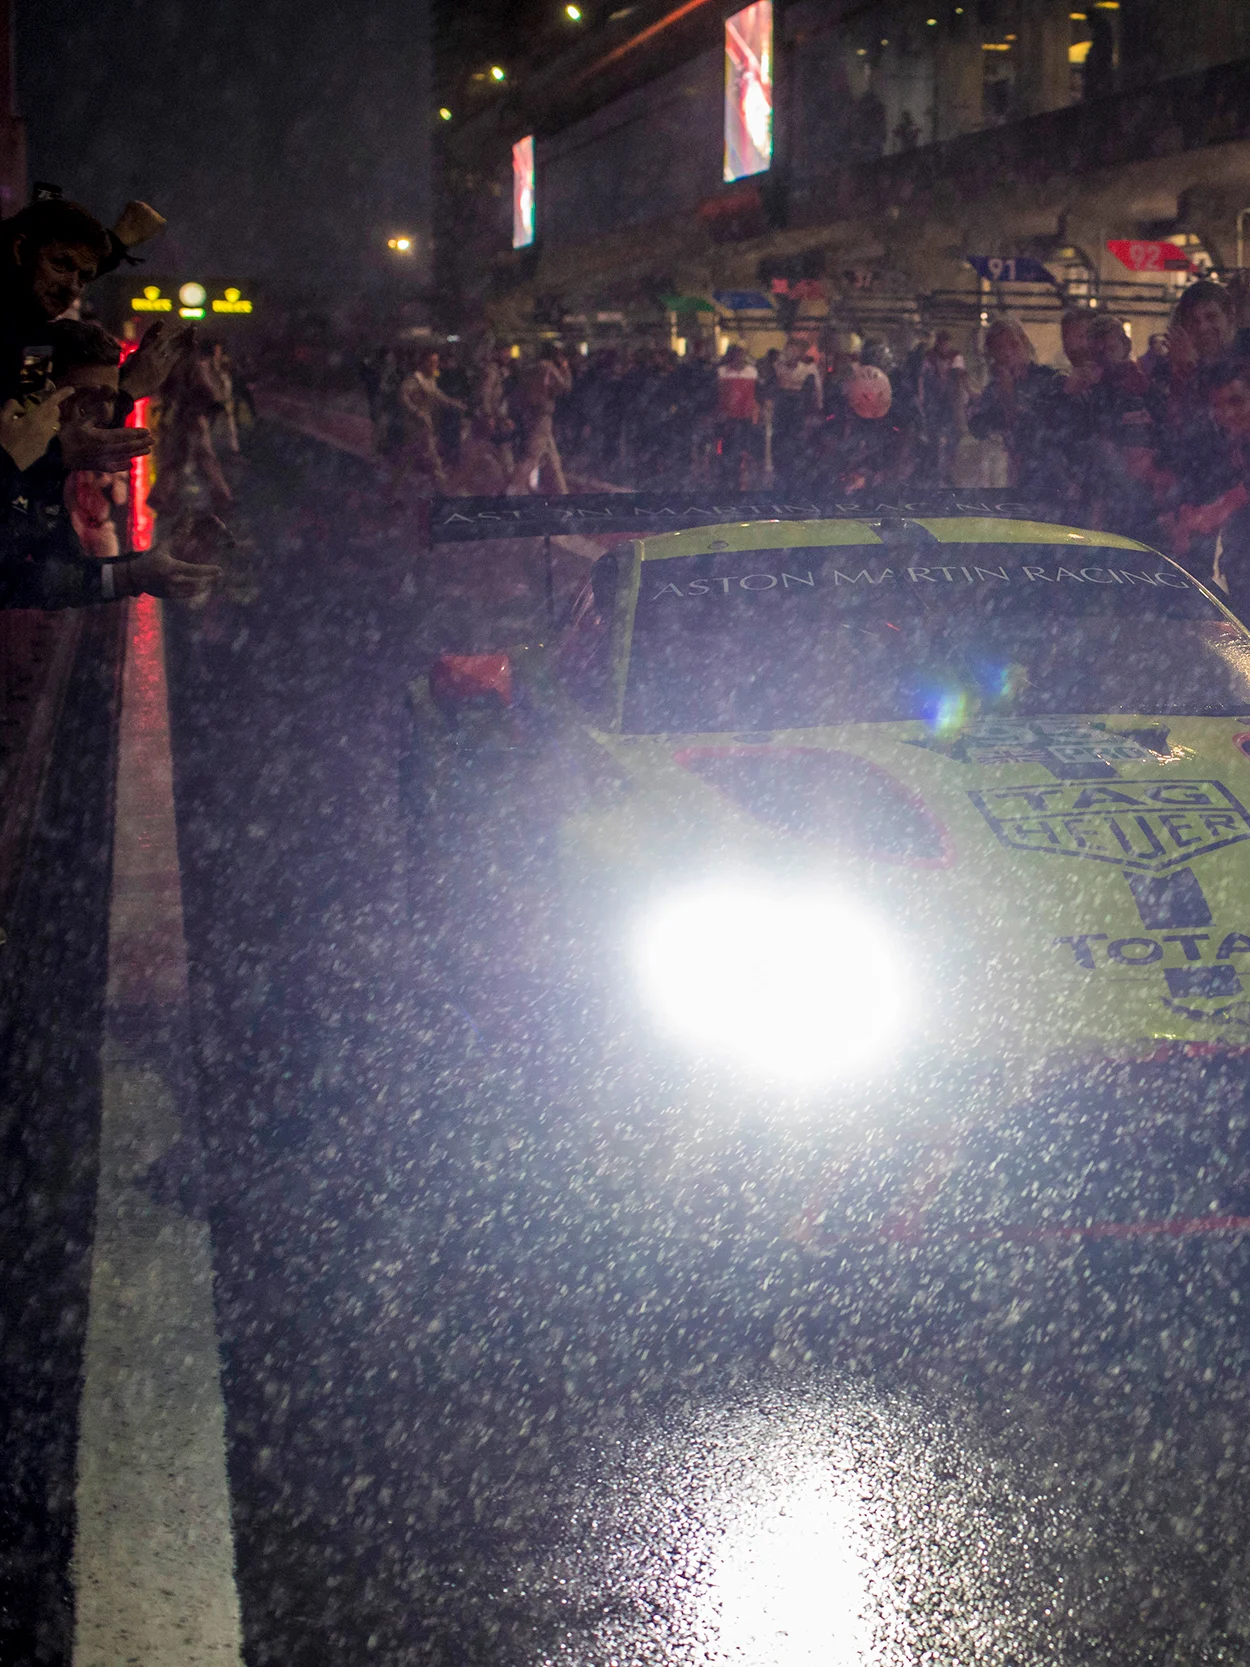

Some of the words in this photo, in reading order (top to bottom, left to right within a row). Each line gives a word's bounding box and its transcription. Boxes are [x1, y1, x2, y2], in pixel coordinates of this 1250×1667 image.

[988, 258, 1017, 280] 91
[1129, 245, 1162, 270] 92
[652, 570, 815, 600] ASTON
[833, 565, 1011, 587] MARTIN
[1022, 565, 1190, 589] RACING
[995, 784, 1213, 811] TAG
[1008, 812, 1241, 860] HEUER
